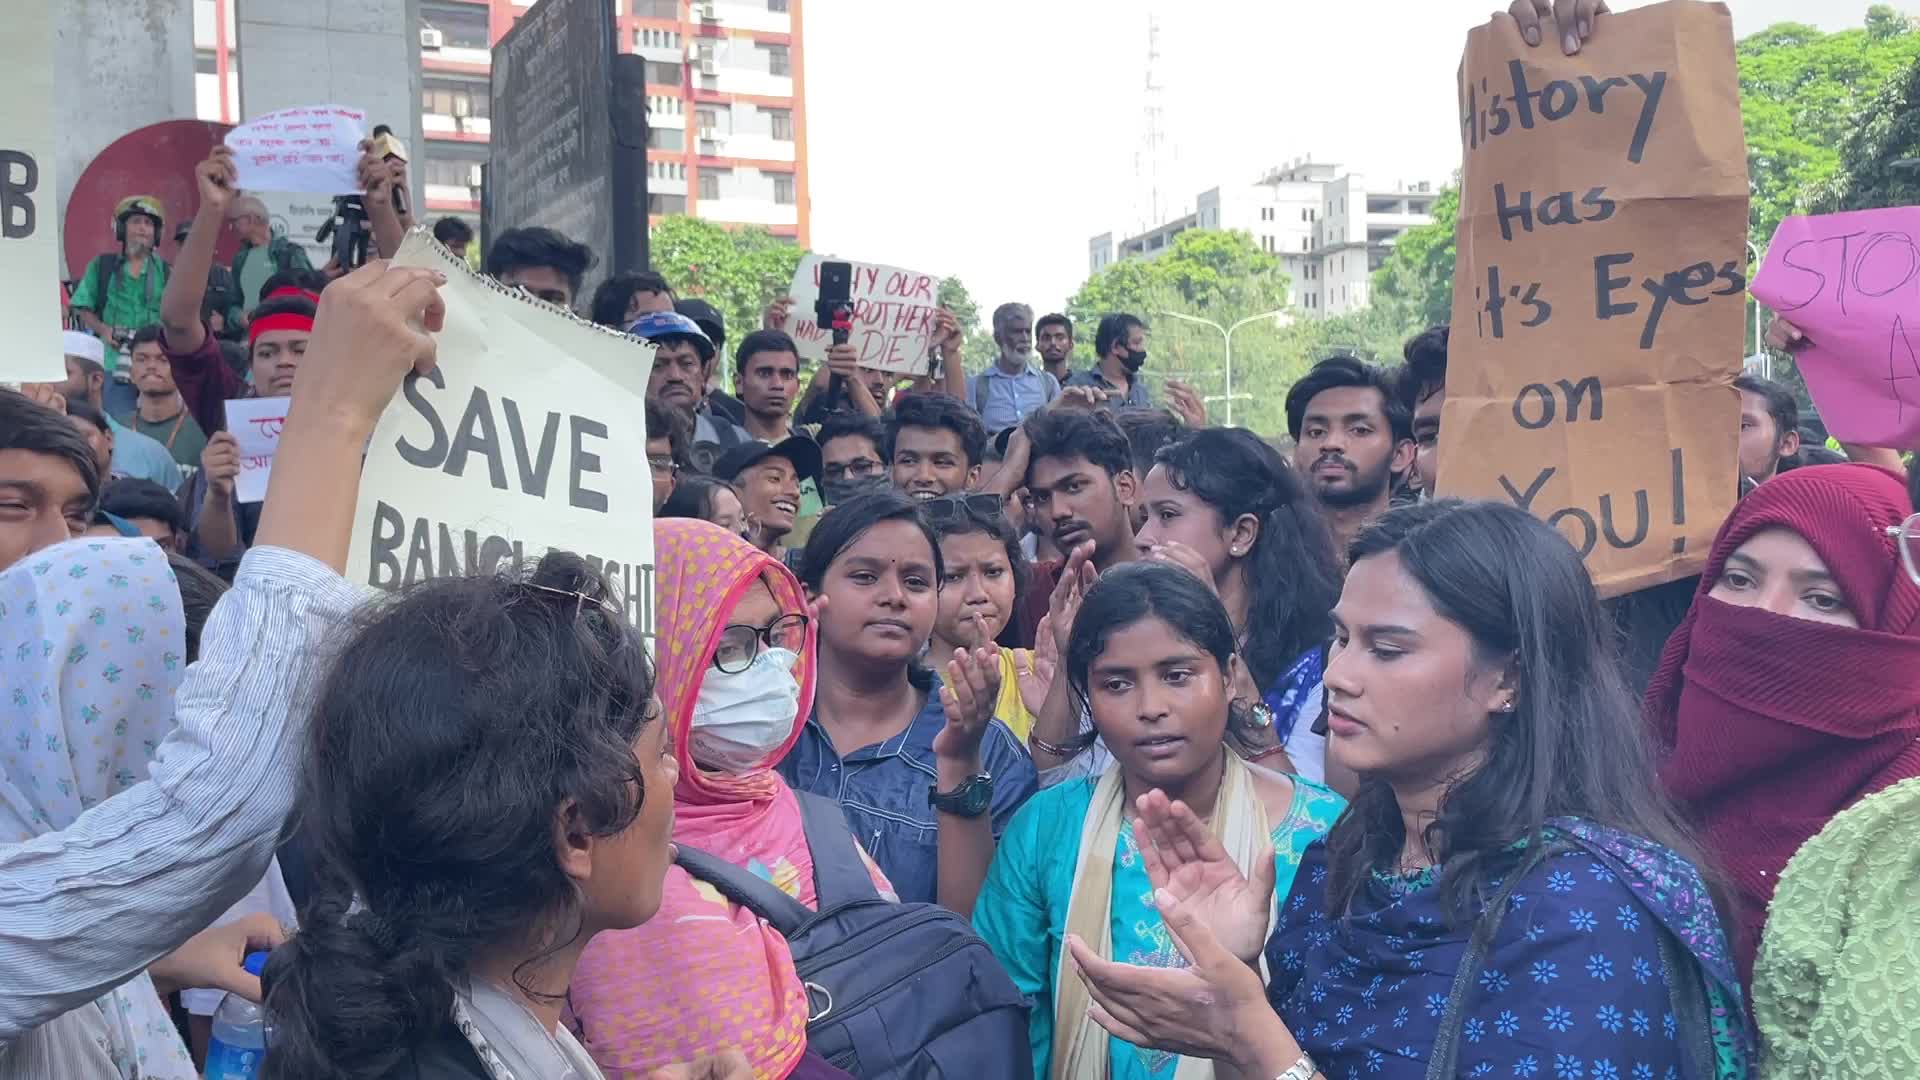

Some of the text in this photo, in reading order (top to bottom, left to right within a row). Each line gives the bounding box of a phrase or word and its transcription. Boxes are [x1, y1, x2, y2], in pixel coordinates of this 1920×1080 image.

[0, 149, 39, 239] B
[1494, 182, 1617, 242] Has
[813, 264, 932, 301] HY OUR
[849, 297, 934, 337] ROTHER
[1593, 252, 1746, 350] Eyes
[394, 362, 609, 514] SAVE
[1512, 376, 1603, 429] on
[367, 499, 655, 638] BANSHI
